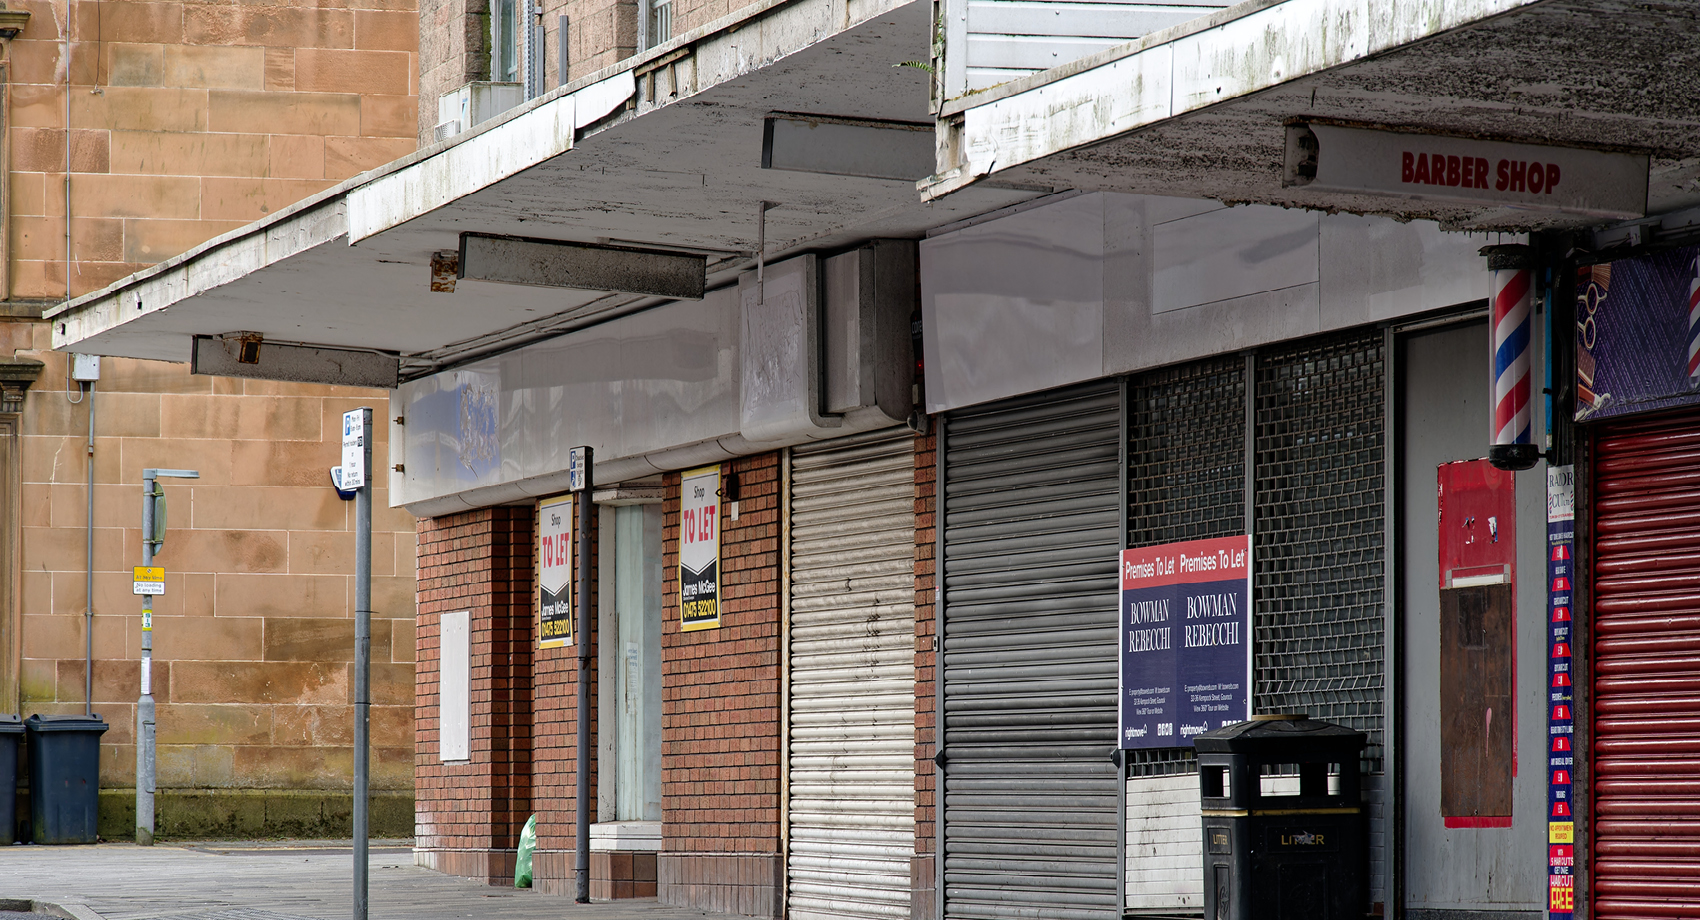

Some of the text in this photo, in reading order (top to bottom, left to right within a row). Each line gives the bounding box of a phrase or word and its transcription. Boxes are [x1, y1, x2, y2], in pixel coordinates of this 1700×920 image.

[1401, 151, 1561, 195] BARBER SHOP
[694, 486, 705, 501] Shop
[551, 513, 561, 528] Shop
[684, 505, 716, 544] TO LET
[542, 532, 569, 568] TO LET
[1180, 548, 1245, 573] Premises To Let
[1125, 556, 1175, 580] Premises To Let
[683, 579, 716, 597] James McGee
[541, 600, 569, 617] James McGee
[1130, 598, 1169, 625] BOWMAN
[1186, 592, 1237, 619] BOWMAN
[1129, 627, 1171, 653] REBECCHI
[1184, 621, 1239, 648] REBECCHI
[1125, 726, 1144, 740] rightmove
[1180, 724, 1204, 738] rightmove
[1212, 834, 1228, 845] LITTER
[1560, 866, 1569, 874] ONE
[1551, 887, 1573, 909] FREE
